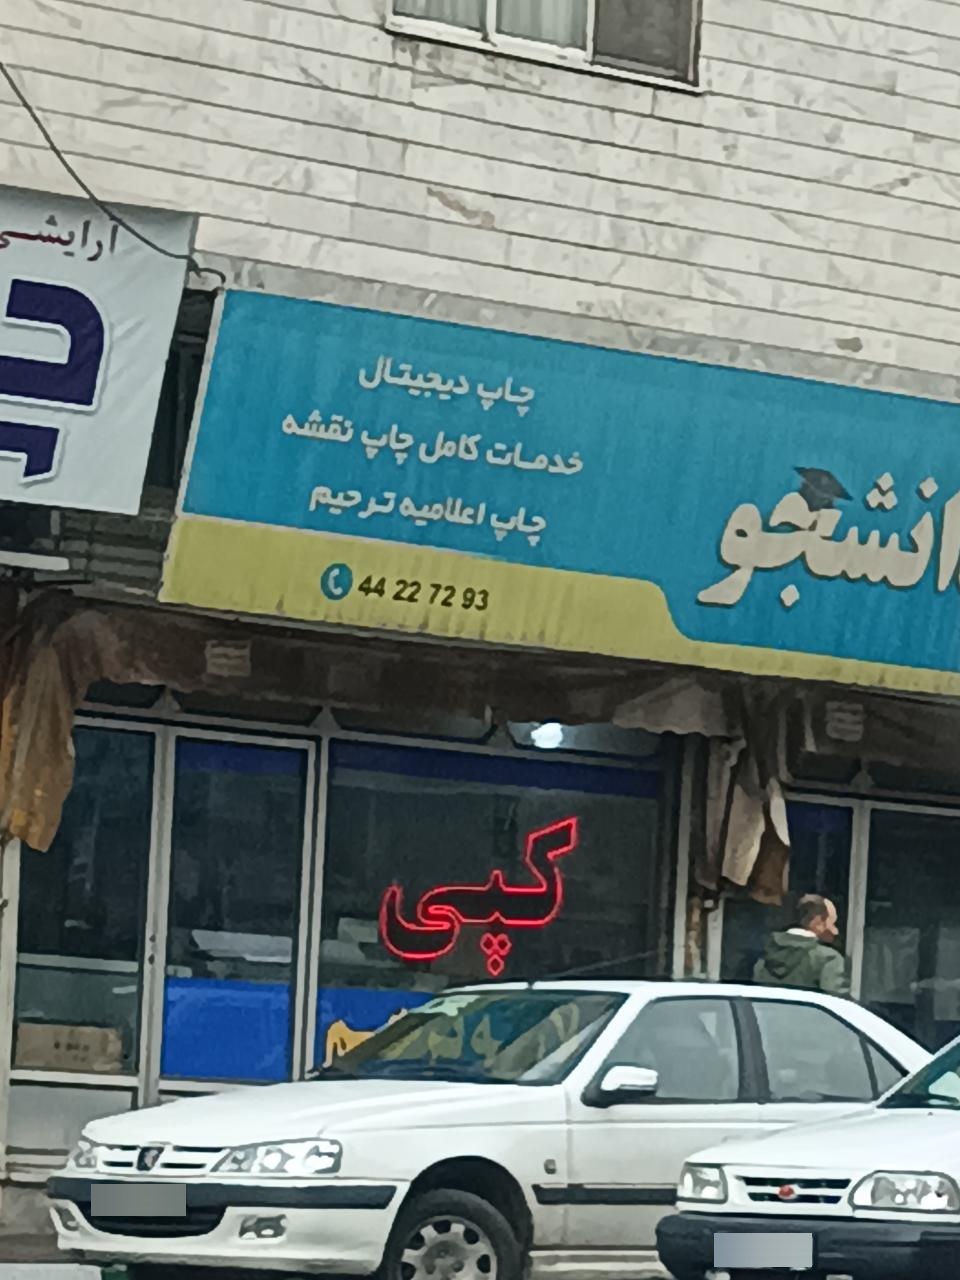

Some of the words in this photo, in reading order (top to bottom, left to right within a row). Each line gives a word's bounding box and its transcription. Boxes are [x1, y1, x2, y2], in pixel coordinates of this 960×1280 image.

[358, 354, 471, 401] دیجیتال
[476, 376, 536, 418] چاپ
[281, 409, 355, 443] نقشه
[360, 423, 415, 466] چاپ
[418, 431, 482, 465] کامل
[485, 442, 584, 476] خدمات
[308, 485, 397, 520] ترحیم
[398, 496, 487, 528] اعلامیه
[489, 507, 548, 548] چاپ
[357, 574, 387, 603] 44
[391, 578, 422, 603] 22
[428, 582, 457, 607] 72
[460, 586, 490, 612] 93
[378, 815, 579, 977] کپی
